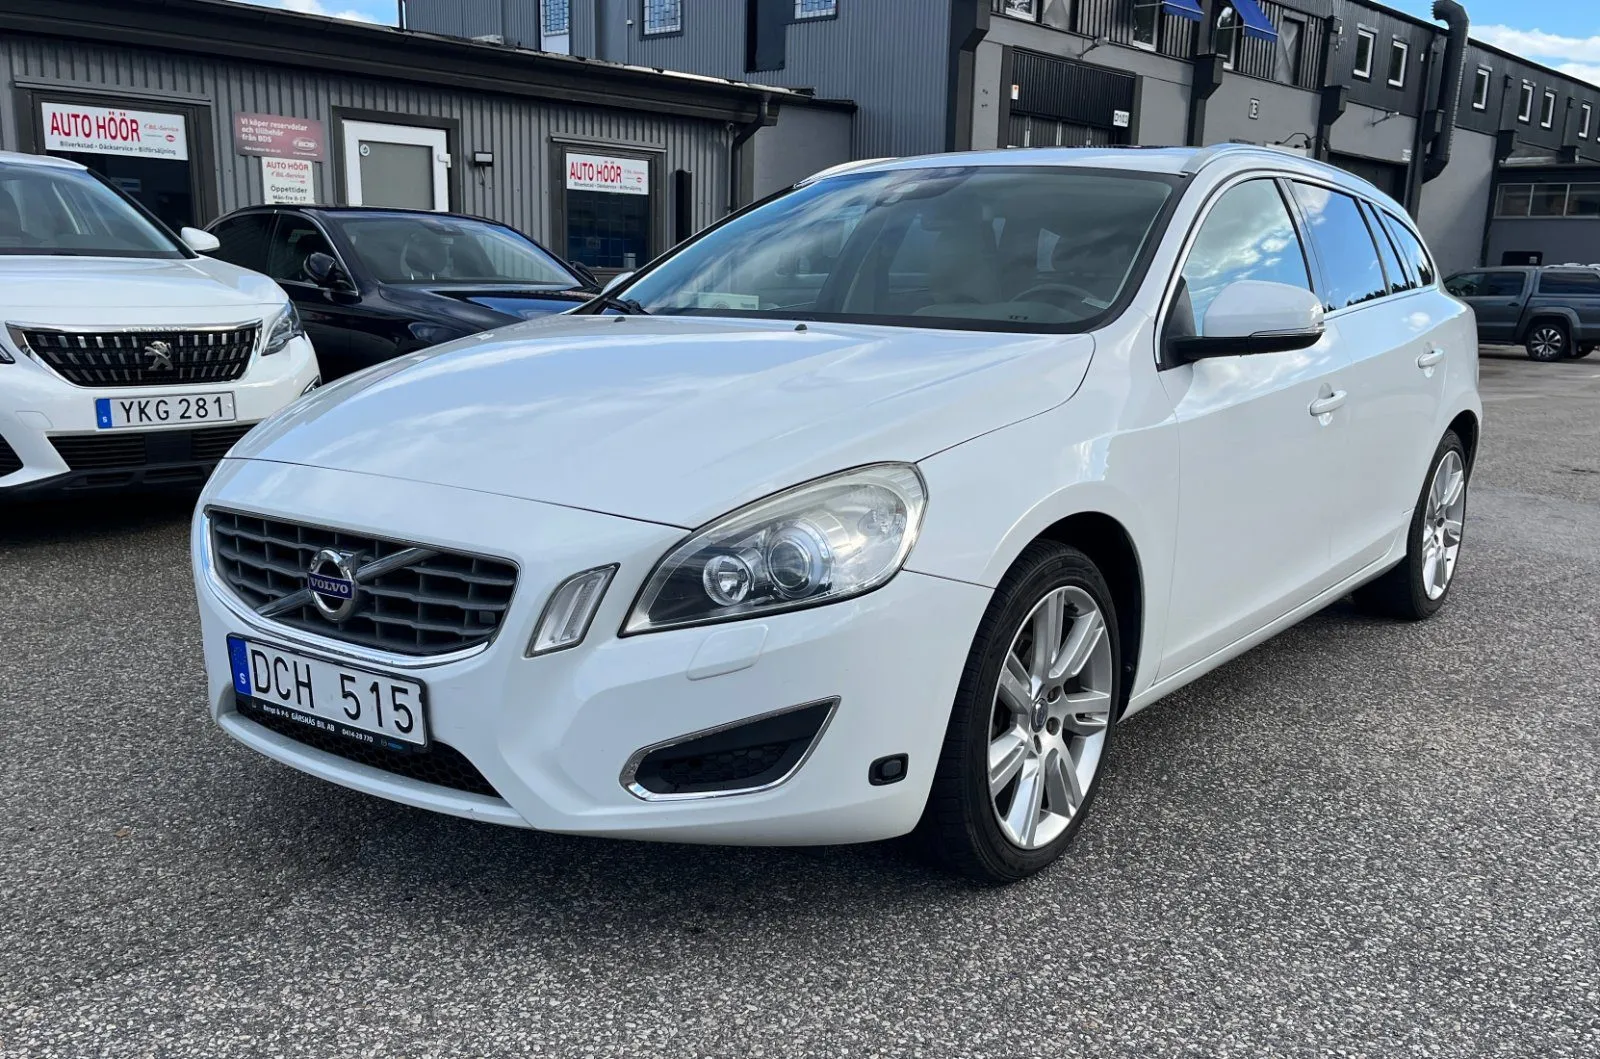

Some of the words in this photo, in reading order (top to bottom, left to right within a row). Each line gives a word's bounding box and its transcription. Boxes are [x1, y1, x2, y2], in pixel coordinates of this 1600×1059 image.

[50, 112, 92, 138] AUTO
[95, 111, 141, 142] HÖÖR
[249, 119, 269, 127] köper
[270, 122, 308, 131] reservdelar
[241, 133, 257, 142] från
[255, 128, 284, 137] tillbehör
[60, 140, 94, 149] Bilverkstad
[99, 143, 133, 152] Däckservice
[138, 146, 177, 156] Bilförsäljning
[266, 161, 286, 170] AUTO
[287, 162, 309, 171] HÖÖR
[569, 161, 594, 181] AUTO
[596, 160, 622, 183] HÖÖR
[270, 184, 307, 194] Öppettider
[119, 400, 170, 424] YKG
[178, 396, 223, 420] 281
[309, 577, 349, 594] VOLVO
[239, 672, 247, 685] S
[251, 649, 315, 709] DCH
[339, 673, 414, 734] 515
[316, 720, 326, 729] BIL
[326, 723, 335, 732] AB
